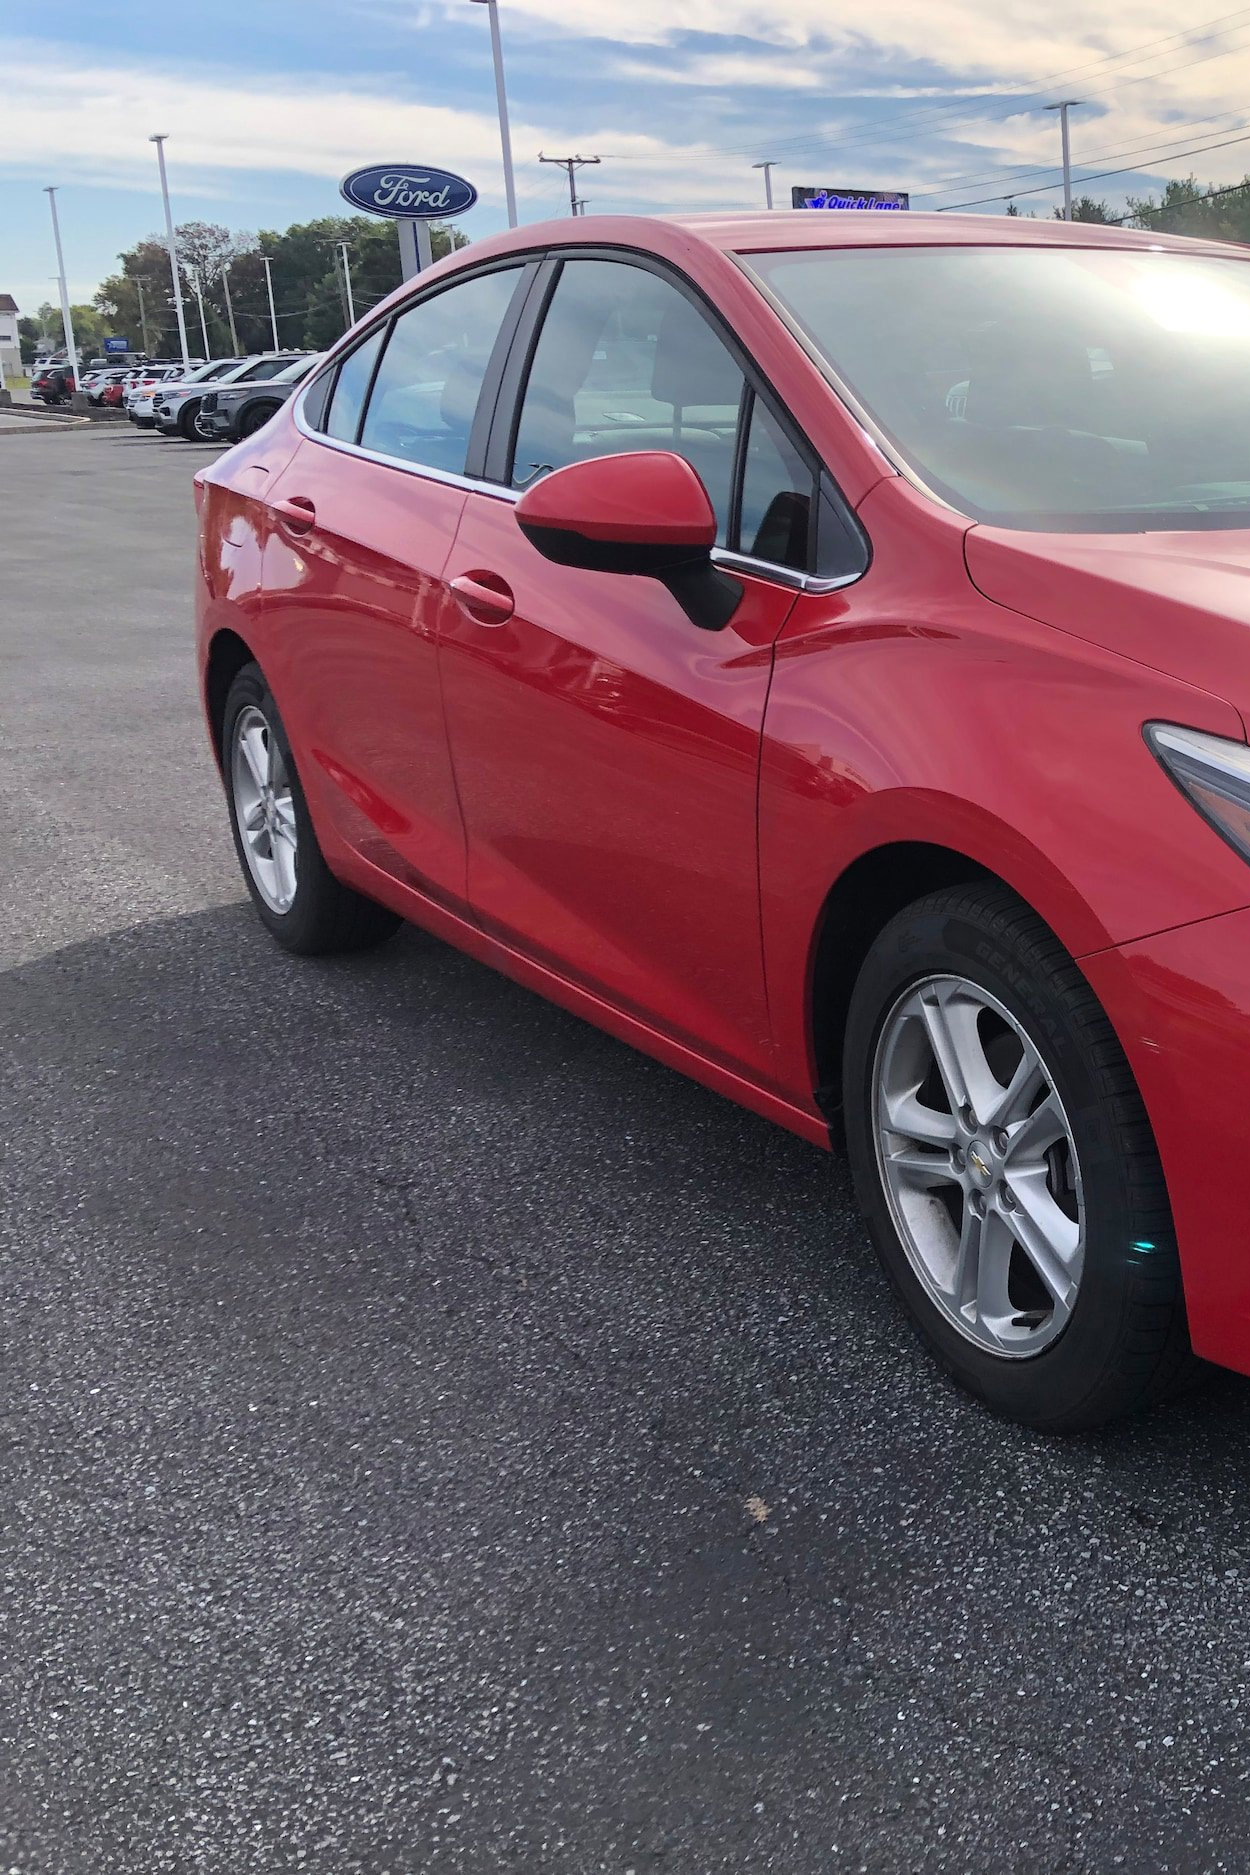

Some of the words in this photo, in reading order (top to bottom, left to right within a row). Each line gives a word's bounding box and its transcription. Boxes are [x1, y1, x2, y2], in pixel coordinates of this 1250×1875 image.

[373, 174, 451, 208] Ford
[828, 194, 867, 210] Quick
[975, 940, 1065, 1059] GENERAL
